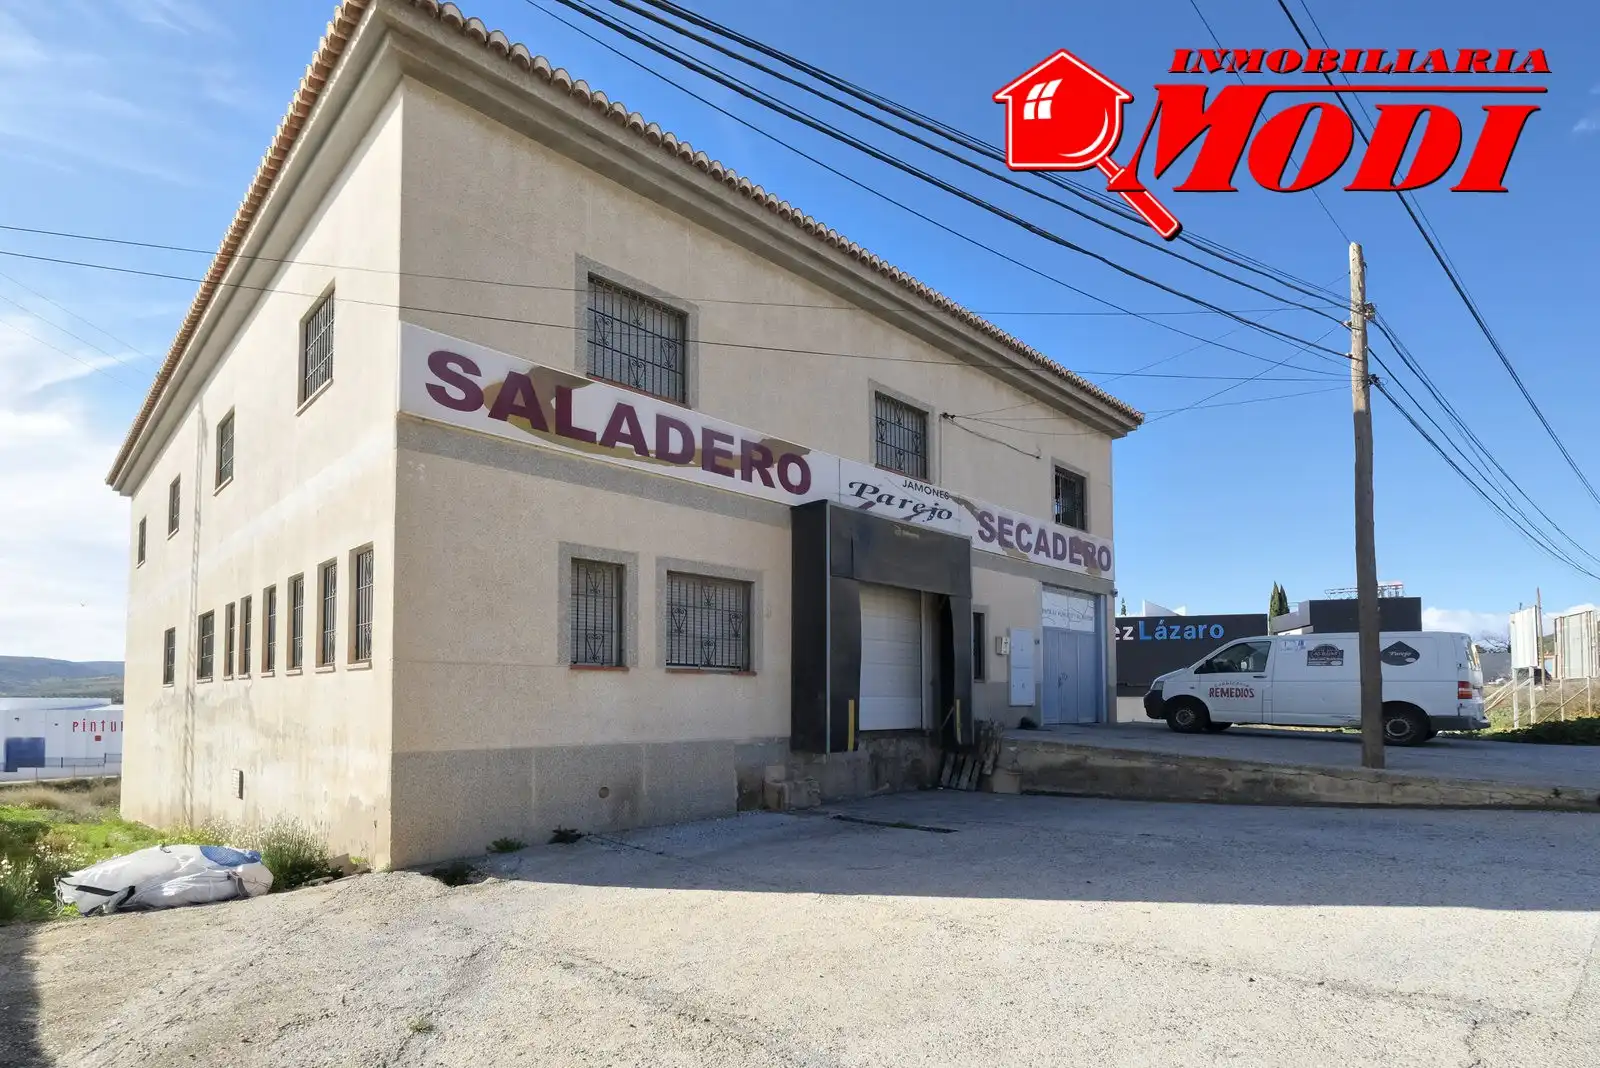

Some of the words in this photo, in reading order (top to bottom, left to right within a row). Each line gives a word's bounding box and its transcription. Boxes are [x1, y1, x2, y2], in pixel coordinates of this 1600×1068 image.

[425, 350, 812, 496] SALADERO
[848, 481, 953, 522] Parejo
[902, 480, 951, 500] JAMONES
[977, 510, 1112, 572] SECADERO
[1138, 619, 1225, 640] Lázaro
[1209, 687, 1255, 698] REMEDIOS
